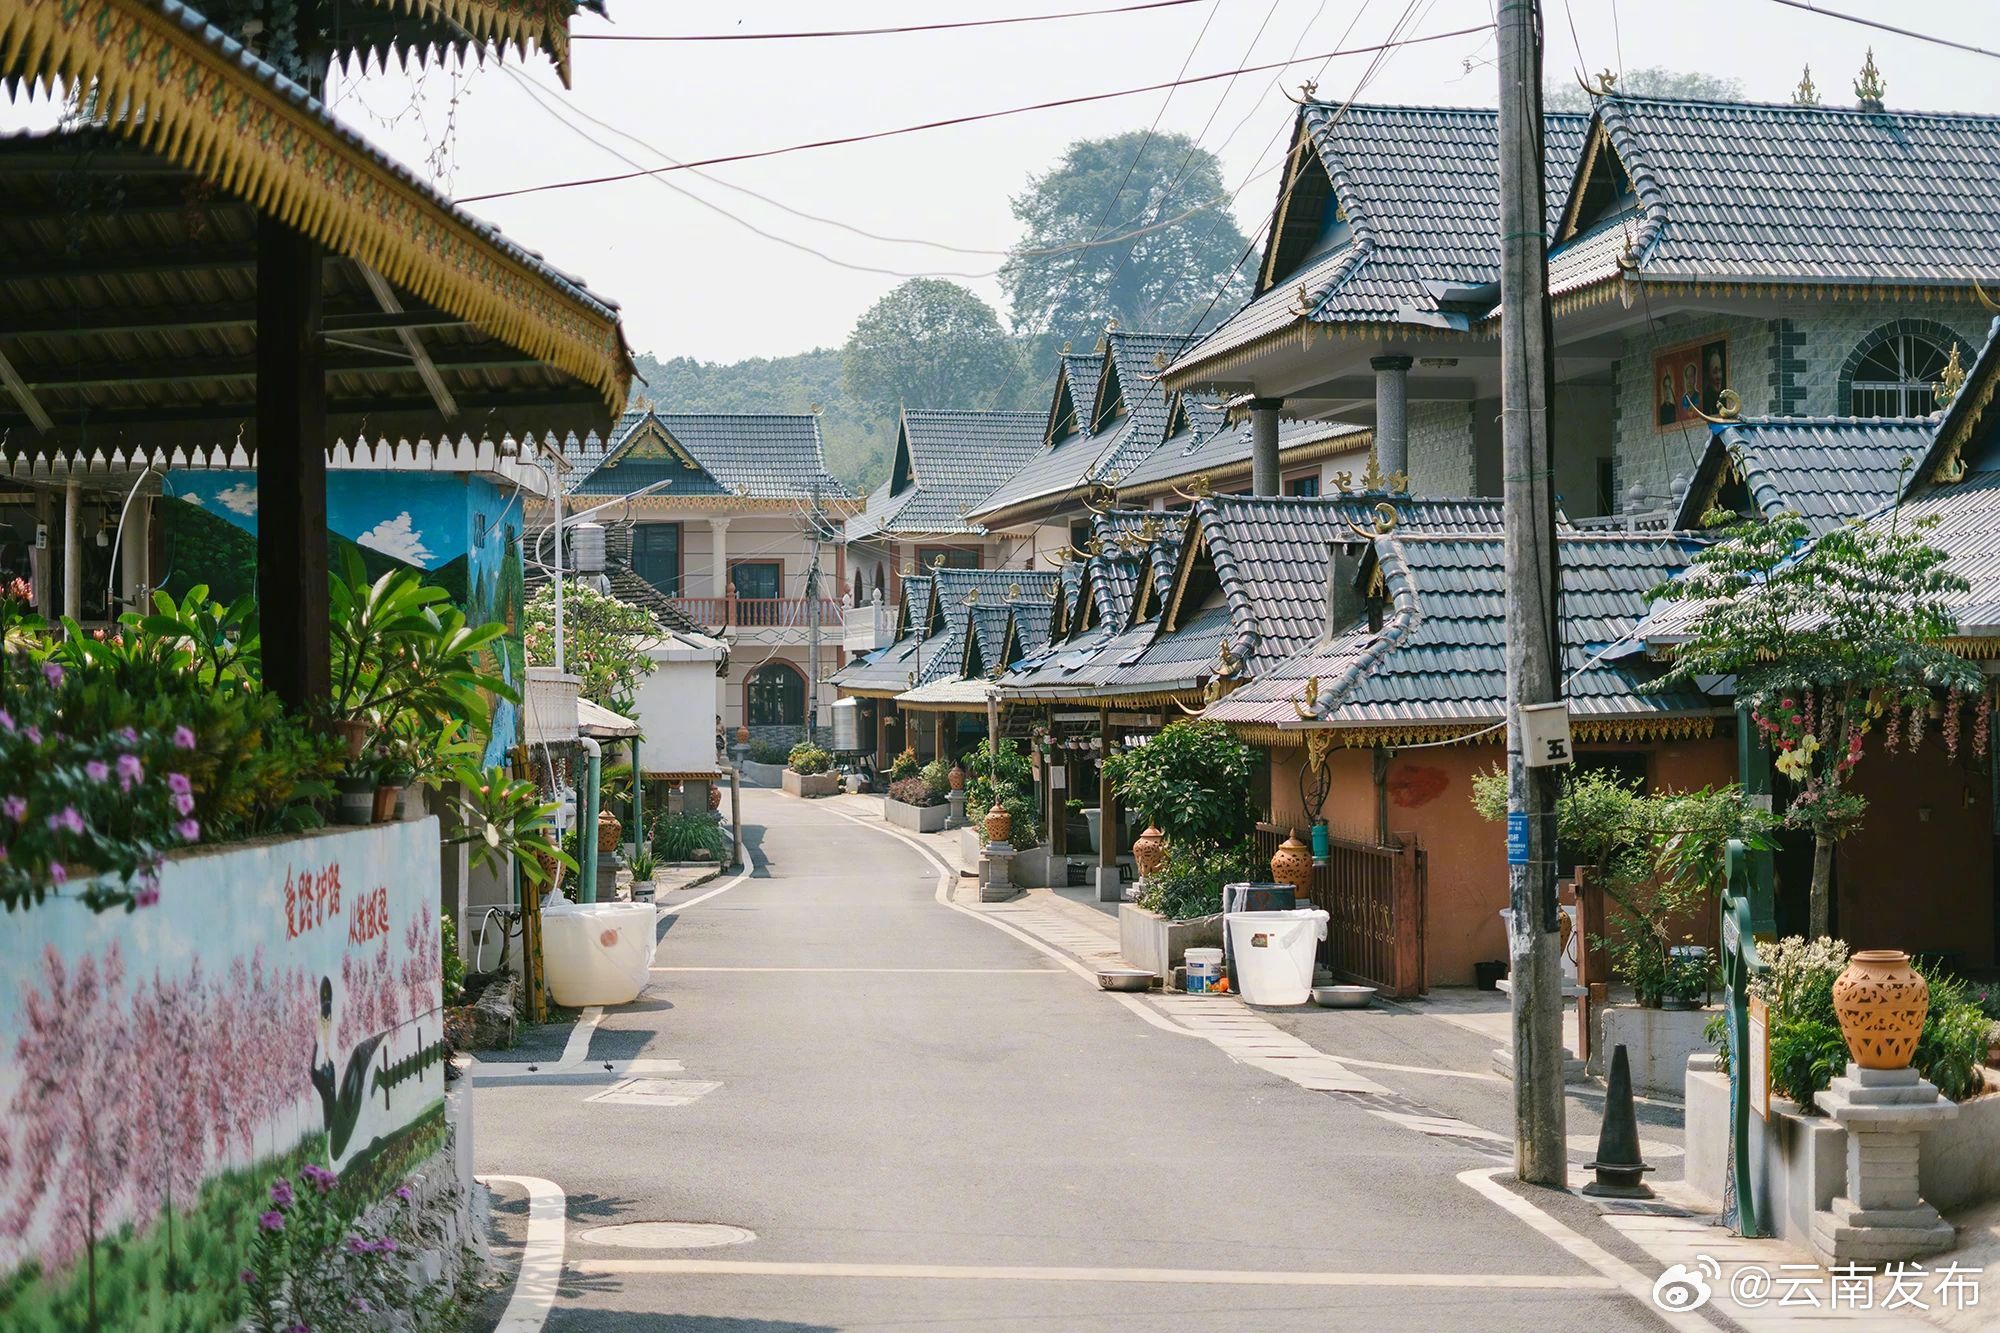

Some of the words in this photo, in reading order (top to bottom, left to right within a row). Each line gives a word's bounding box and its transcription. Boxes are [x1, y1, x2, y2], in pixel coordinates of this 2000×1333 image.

[1547, 738, 1568, 760] 五
[284, 860, 341, 943] 爱路护路
